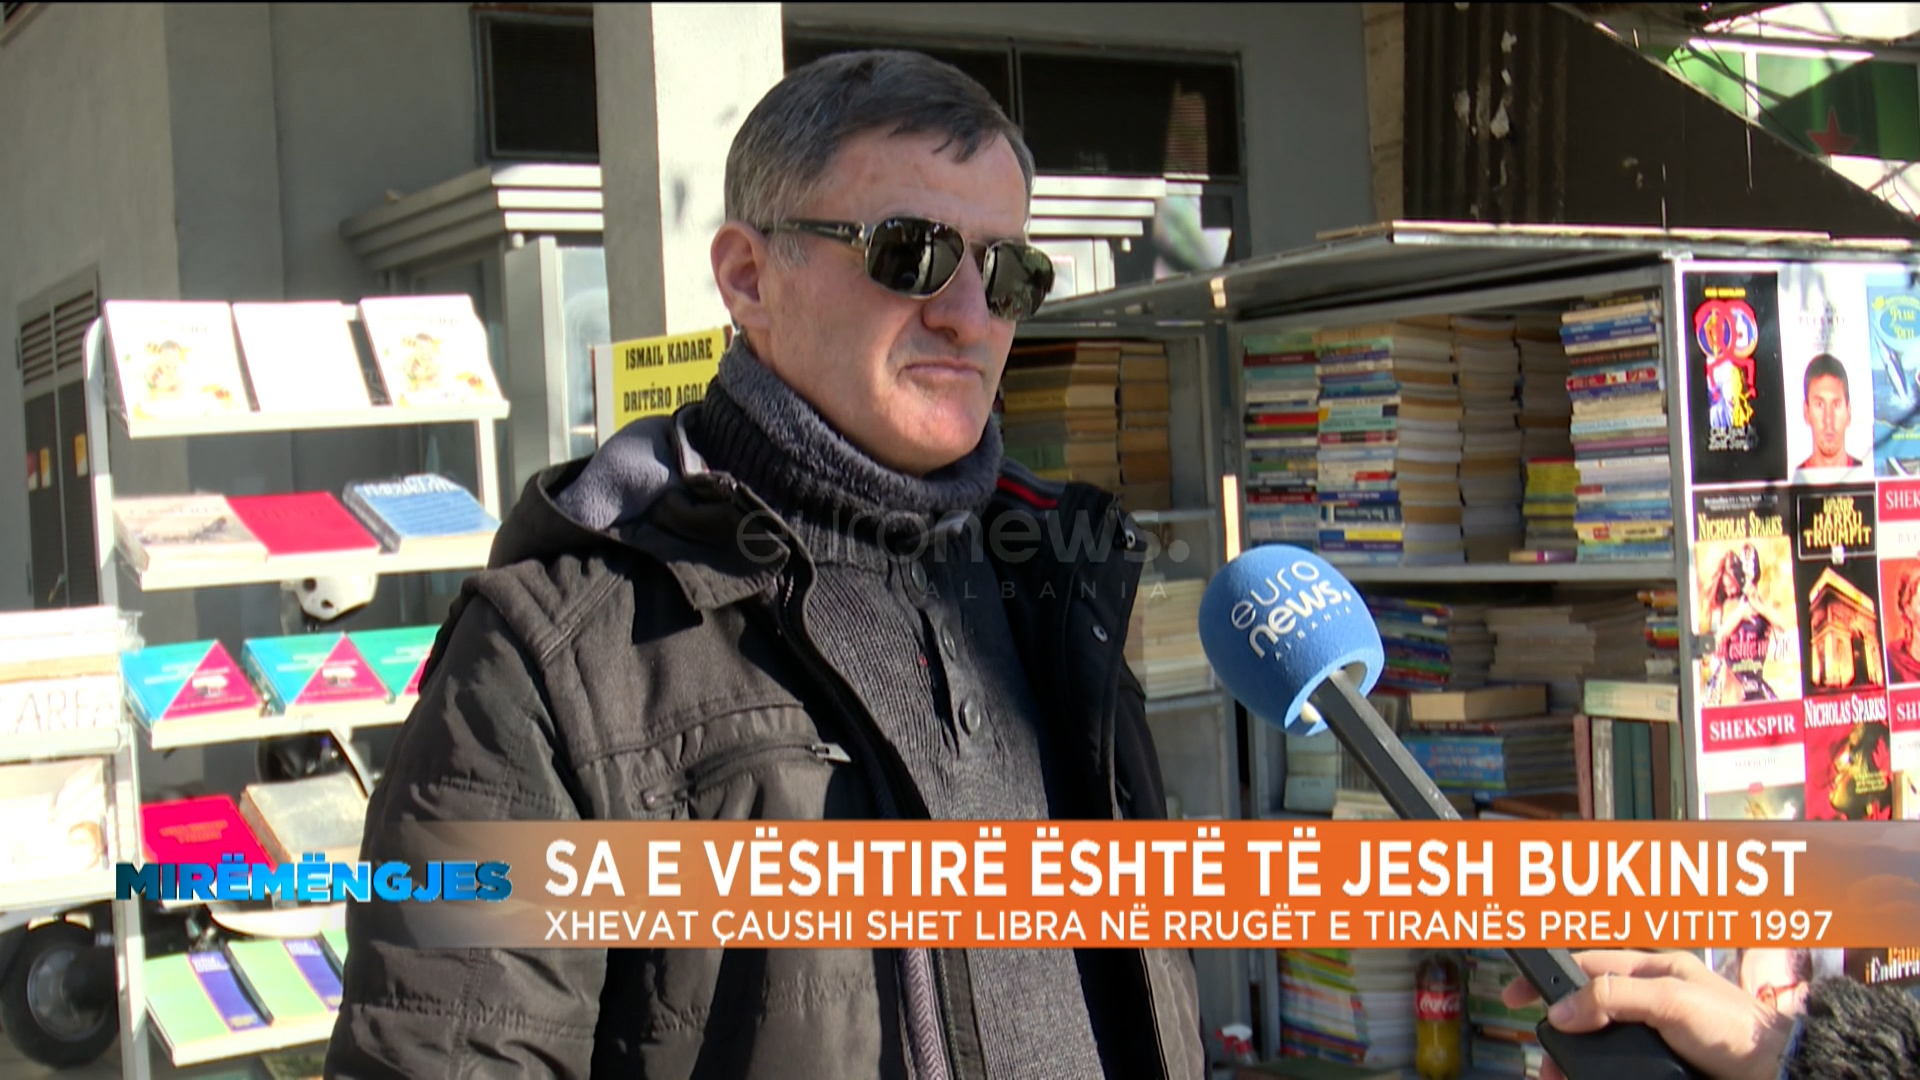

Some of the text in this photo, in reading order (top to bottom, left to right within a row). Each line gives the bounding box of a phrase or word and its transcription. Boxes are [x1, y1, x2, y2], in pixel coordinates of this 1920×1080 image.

[625, 337, 713, 371] ISMAIL KADARE
[1697, 510, 1783, 541] NICHOLAS SPARKS
[1231, 560, 1320, 630] euro
[1709, 714, 1796, 742] SHEKSPIR
[1804, 694, 1887, 728] NICHOLAS SPARKS
